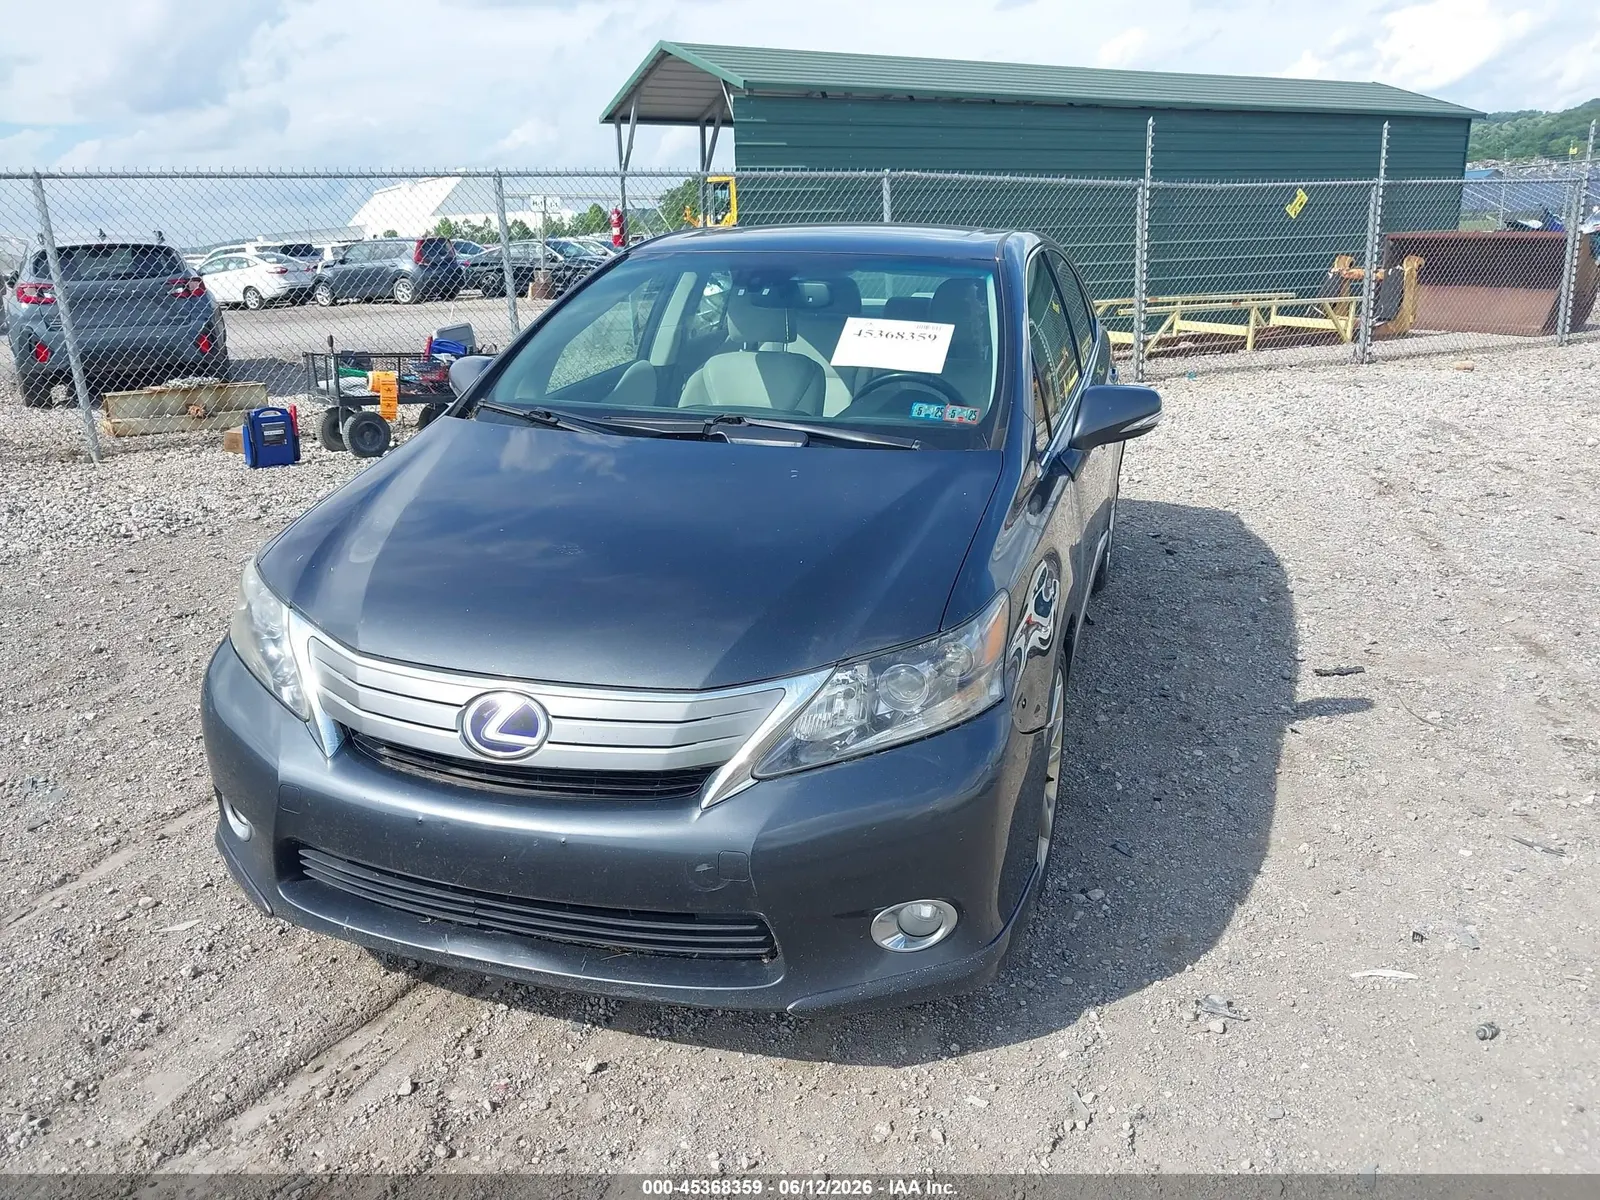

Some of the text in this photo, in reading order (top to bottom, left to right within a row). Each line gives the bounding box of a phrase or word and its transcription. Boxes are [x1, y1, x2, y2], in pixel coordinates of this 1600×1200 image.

[853, 329, 938, 342] 45368359
[934, 407, 944, 418] 25
[967, 410, 977, 421] 25
